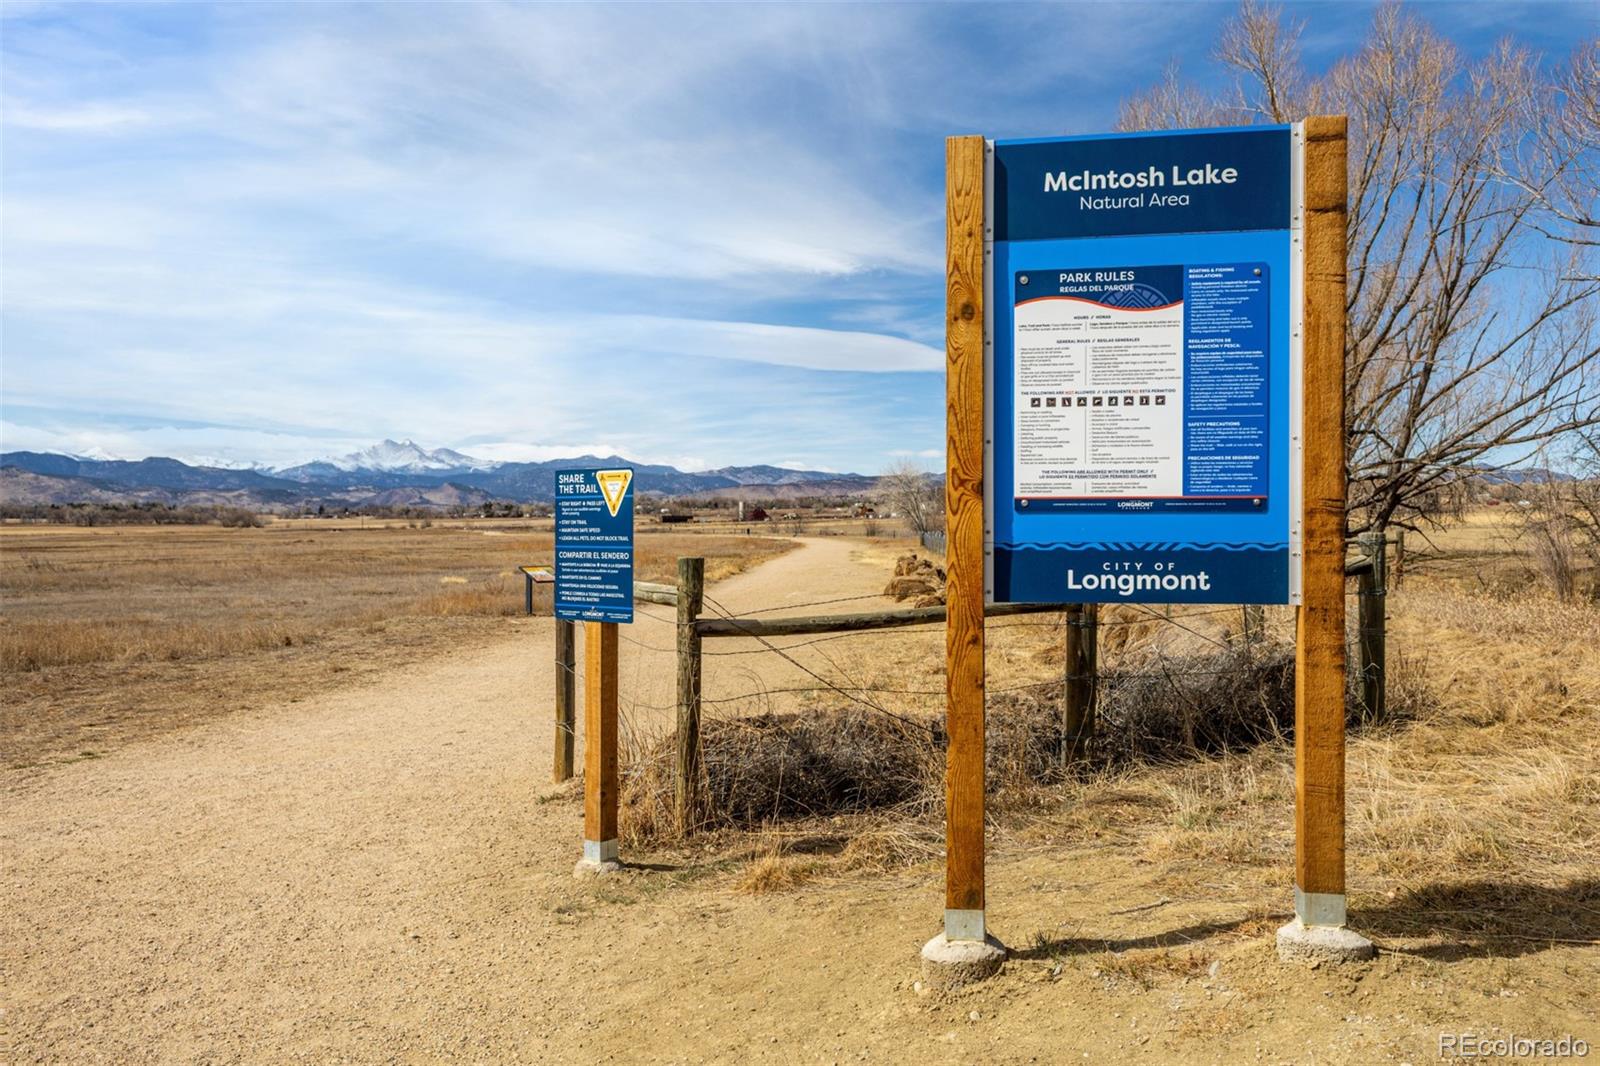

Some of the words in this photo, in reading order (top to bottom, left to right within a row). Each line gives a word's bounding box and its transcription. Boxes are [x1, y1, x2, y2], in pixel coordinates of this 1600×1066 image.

[1044, 166, 1164, 192] McIntosh
[1172, 164, 1238, 186] Lake
[1080, 193, 1144, 210] Natural
[1149, 192, 1190, 206] Area
[1060, 272, 1092, 283] PARK
[1096, 271, 1134, 282] RULES
[558, 474, 584, 484] SHARE
[559, 485, 574, 494] THE
[575, 484, 598, 494] TRAIL
[1102, 562, 1143, 571] CITY
[1154, 562, 1175, 571] OF
[1067, 570, 1211, 596] Longmont
